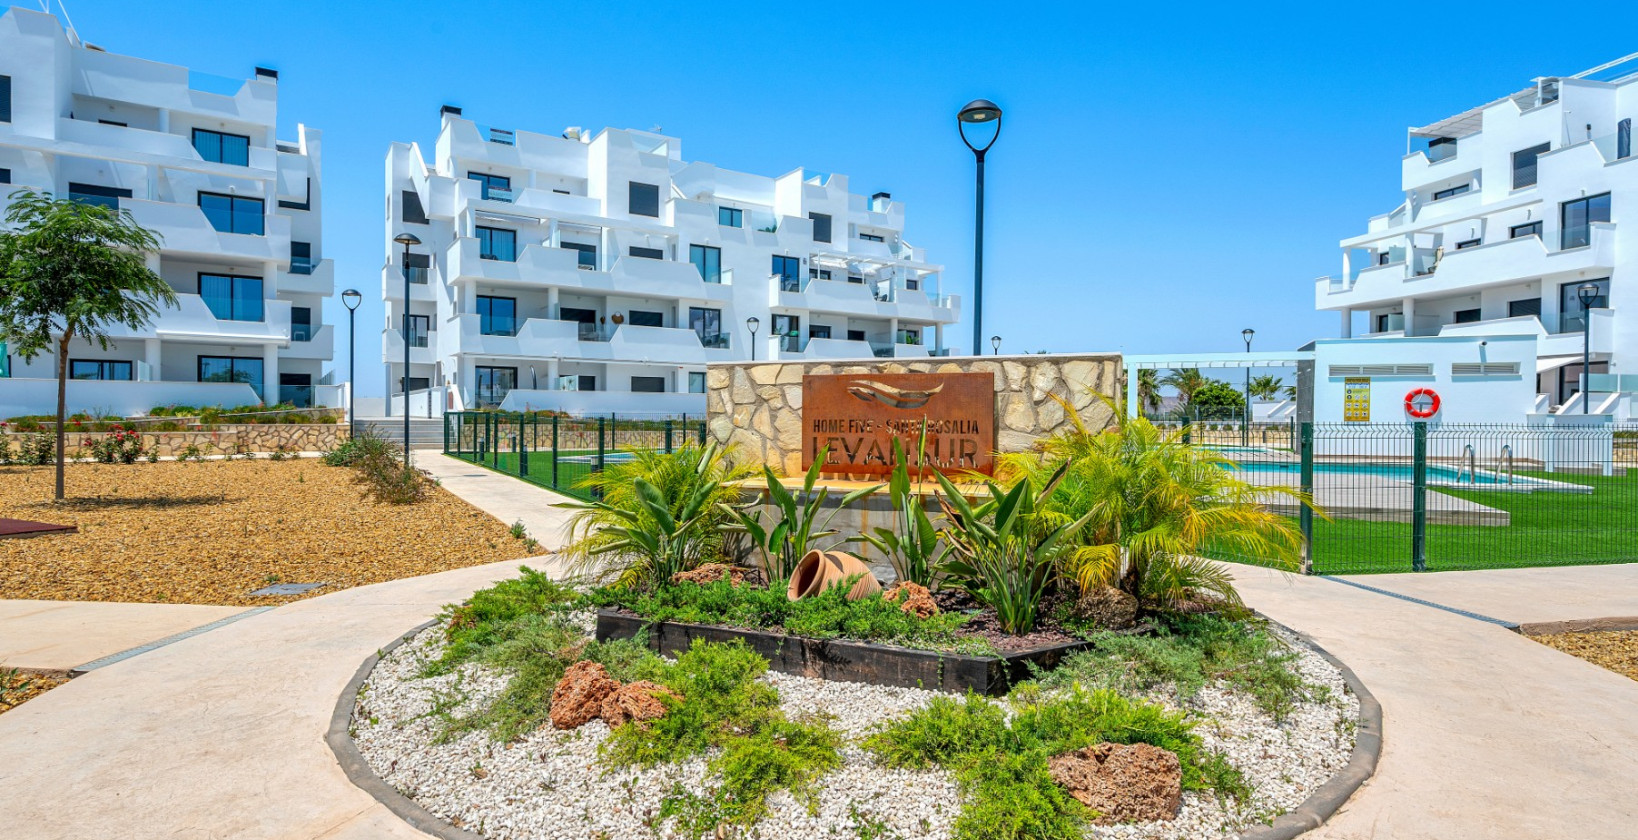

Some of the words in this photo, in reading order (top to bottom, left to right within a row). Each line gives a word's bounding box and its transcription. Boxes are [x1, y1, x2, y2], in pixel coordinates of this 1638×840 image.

[813, 419, 845, 433] HOME
[849, 419, 874, 434] FIVE
[927, 419, 979, 434] ROSALIA
